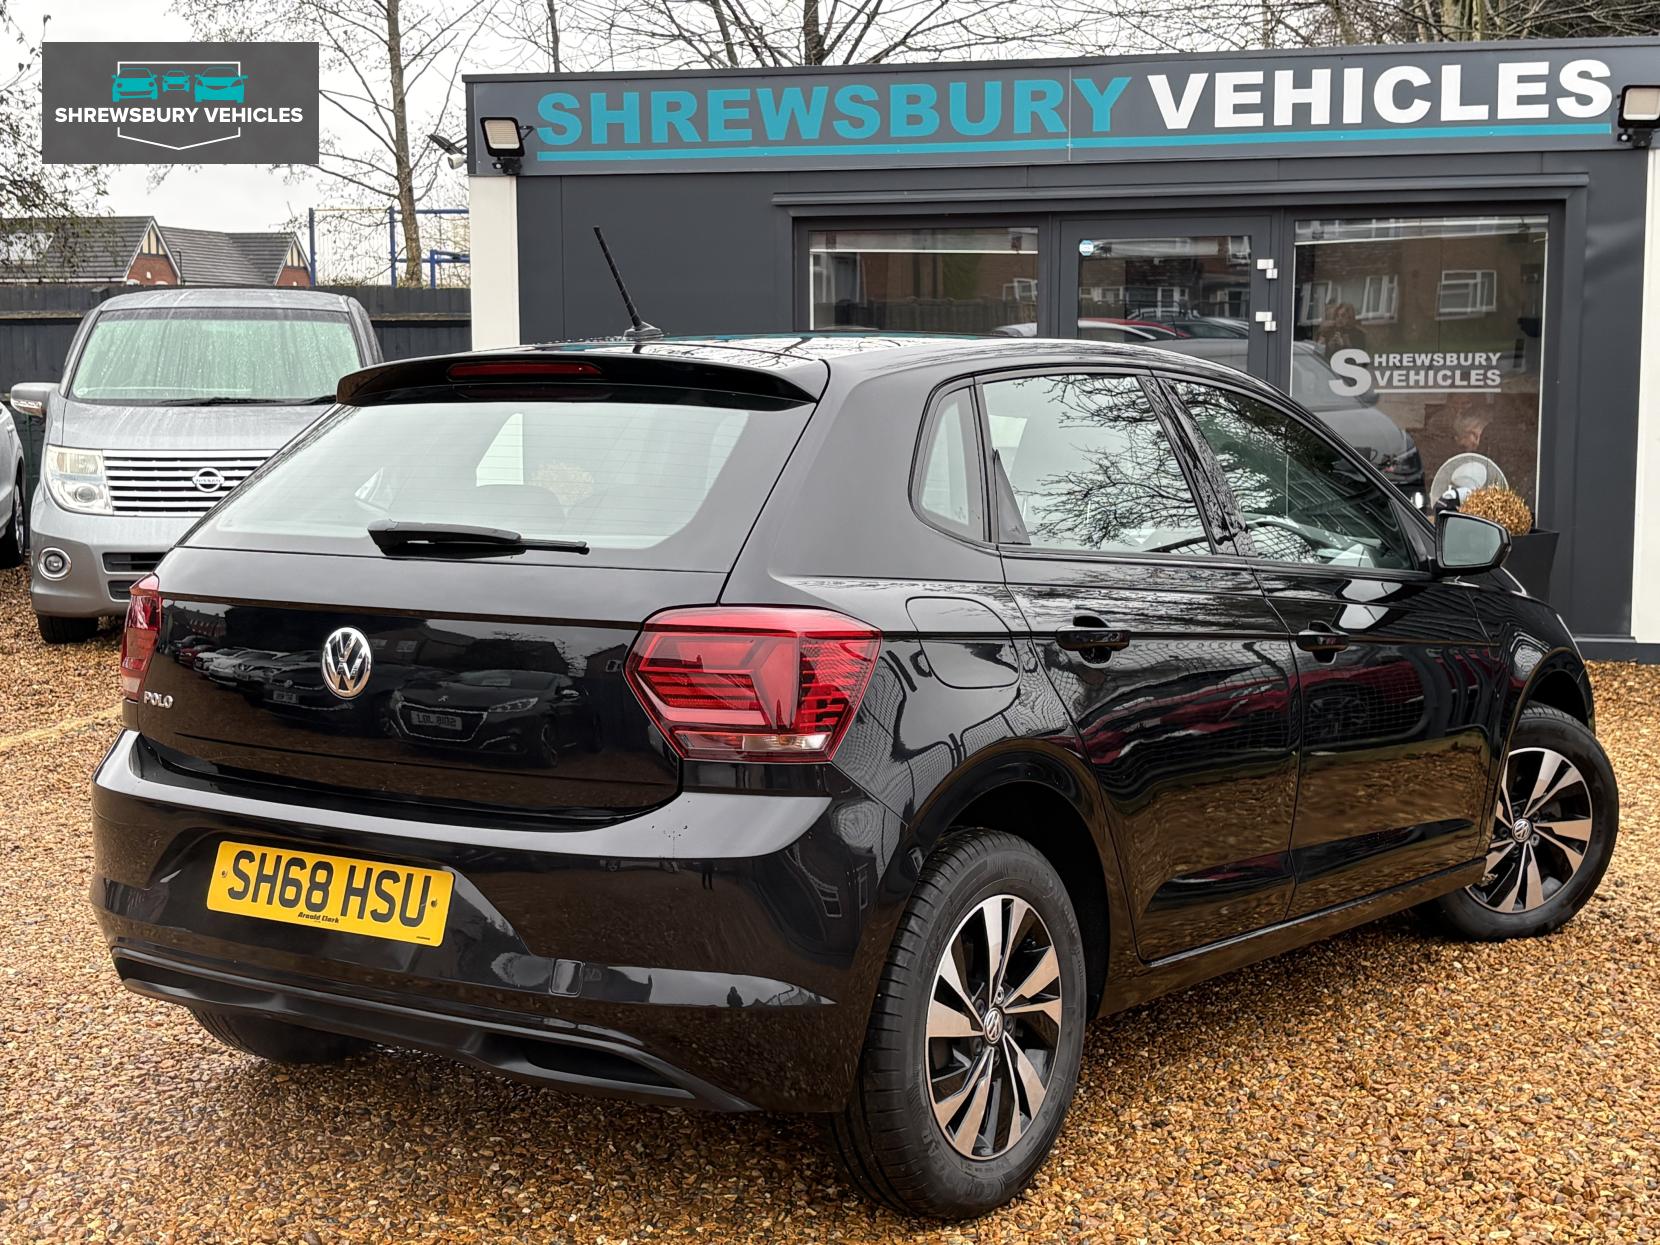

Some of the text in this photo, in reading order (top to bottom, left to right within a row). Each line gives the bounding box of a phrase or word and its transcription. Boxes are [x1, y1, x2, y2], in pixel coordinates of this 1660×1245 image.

[536, 59, 1613, 146] SHREWSBURY VEHICLES
[1328, 348, 1502, 397] SHREWSBURY
[1374, 369, 1502, 388] VEHICLES
[143, 690, 174, 709] POLO
[227, 849, 432, 928] SH68 HSU
[298, 911, 339, 923] Arnold Clark
